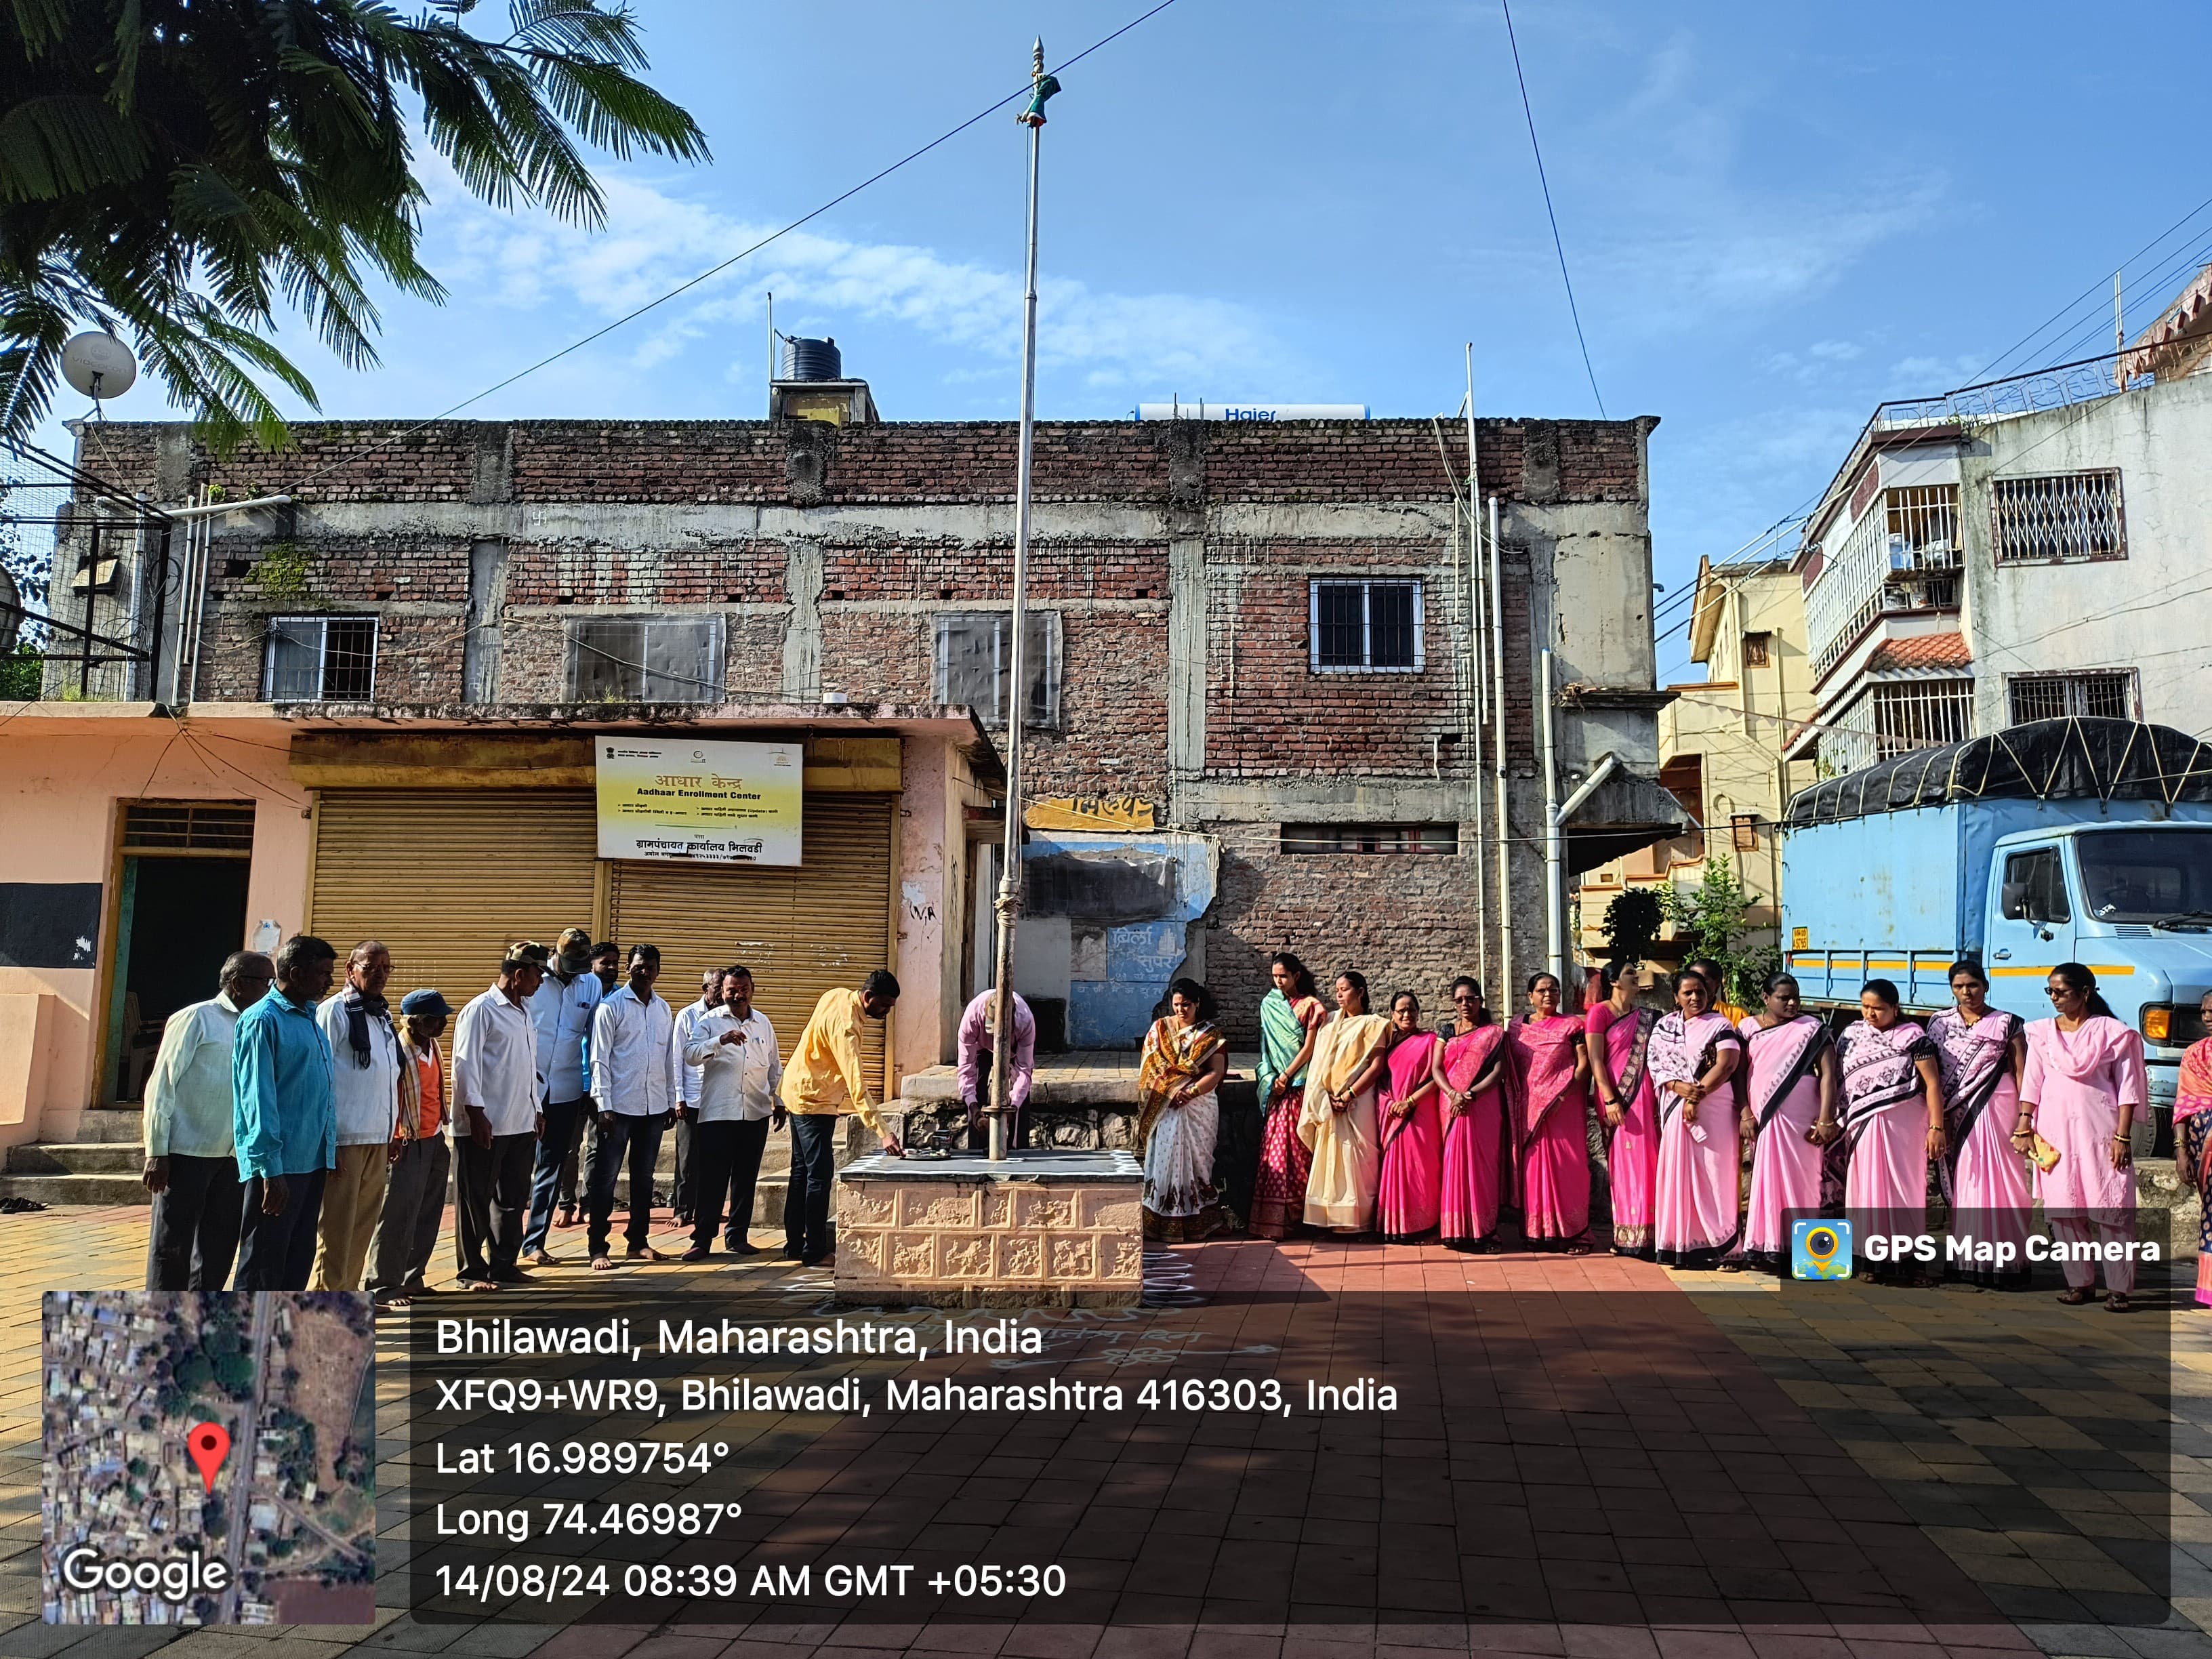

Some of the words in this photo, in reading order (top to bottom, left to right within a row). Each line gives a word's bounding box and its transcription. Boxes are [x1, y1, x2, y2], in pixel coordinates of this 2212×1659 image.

[655, 775, 702, 788] आधार
[711, 773, 743, 790] केन्द्र
[637, 788, 676, 796] Aadhaar
[678, 790, 728, 798] Enrollment
[731, 792, 761, 800] Center
[636, 838, 684, 850] ग्रामपंचायत
[687, 840, 725, 852] कार्यालय
[728, 841, 763, 853] भिलवडी
